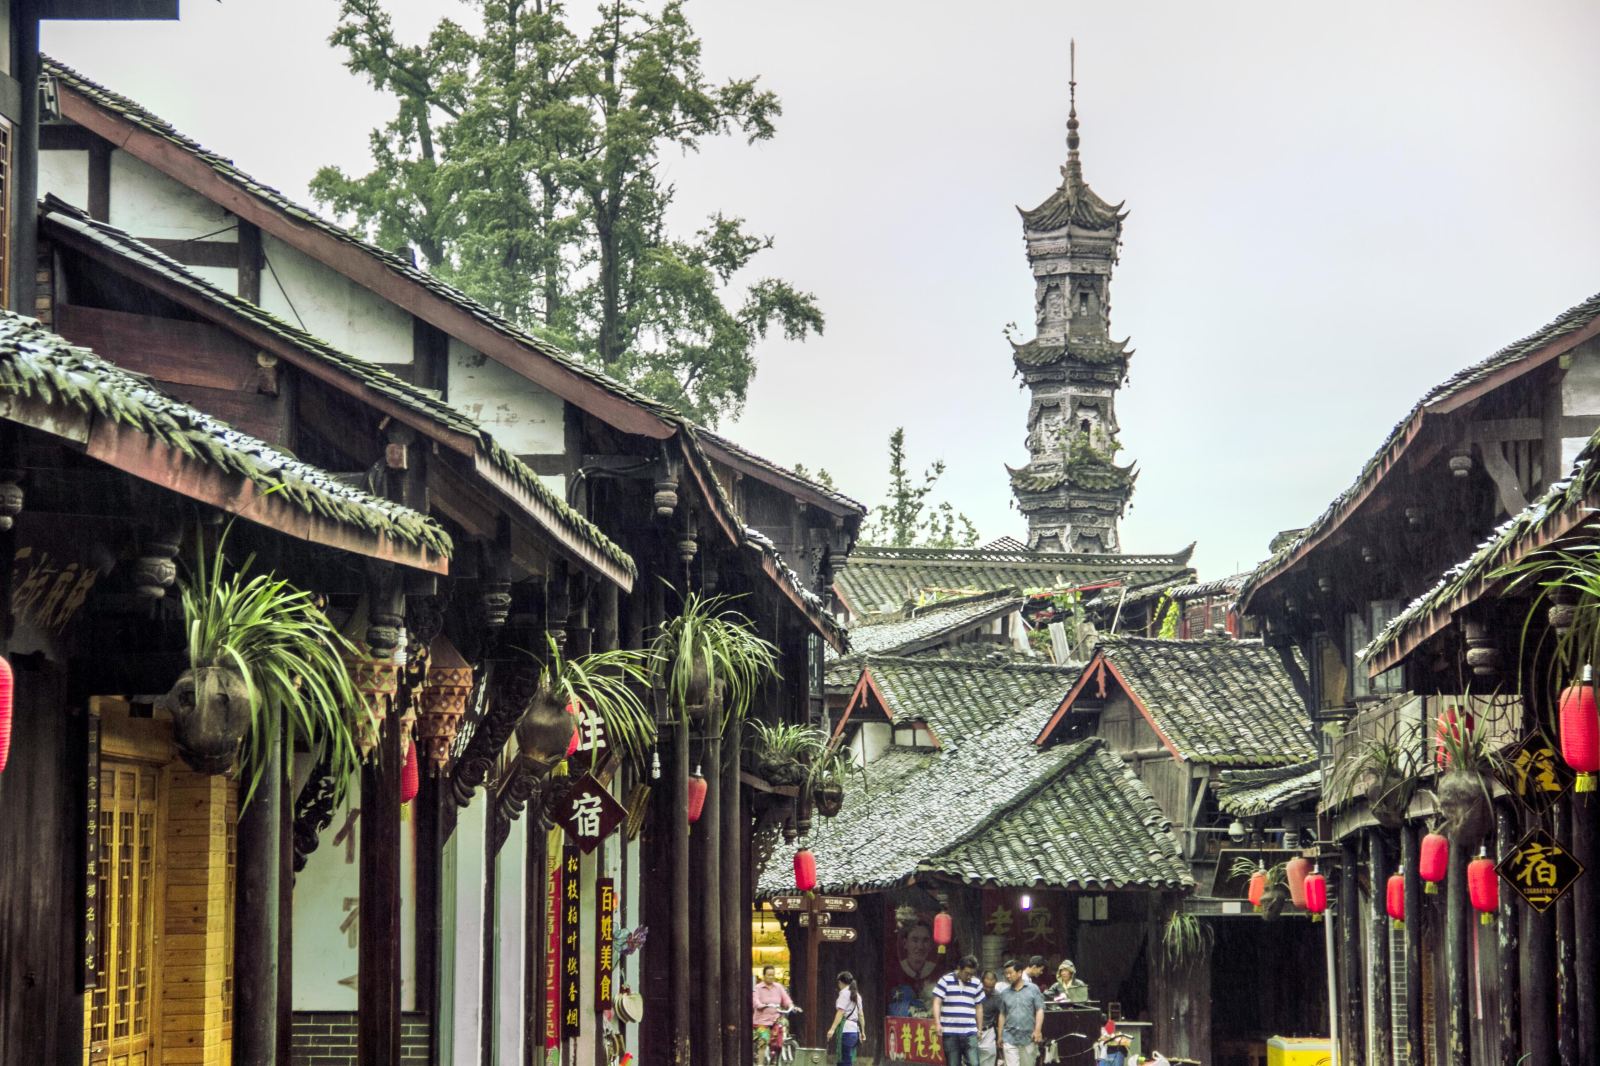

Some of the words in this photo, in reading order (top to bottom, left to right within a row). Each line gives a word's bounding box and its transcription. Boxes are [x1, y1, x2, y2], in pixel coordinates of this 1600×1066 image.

[577, 709, 607, 751] 住
[569, 792, 603, 837] 宿
[1514, 842, 1563, 887] 宿
[599, 885, 613, 1002] 百姓美食
